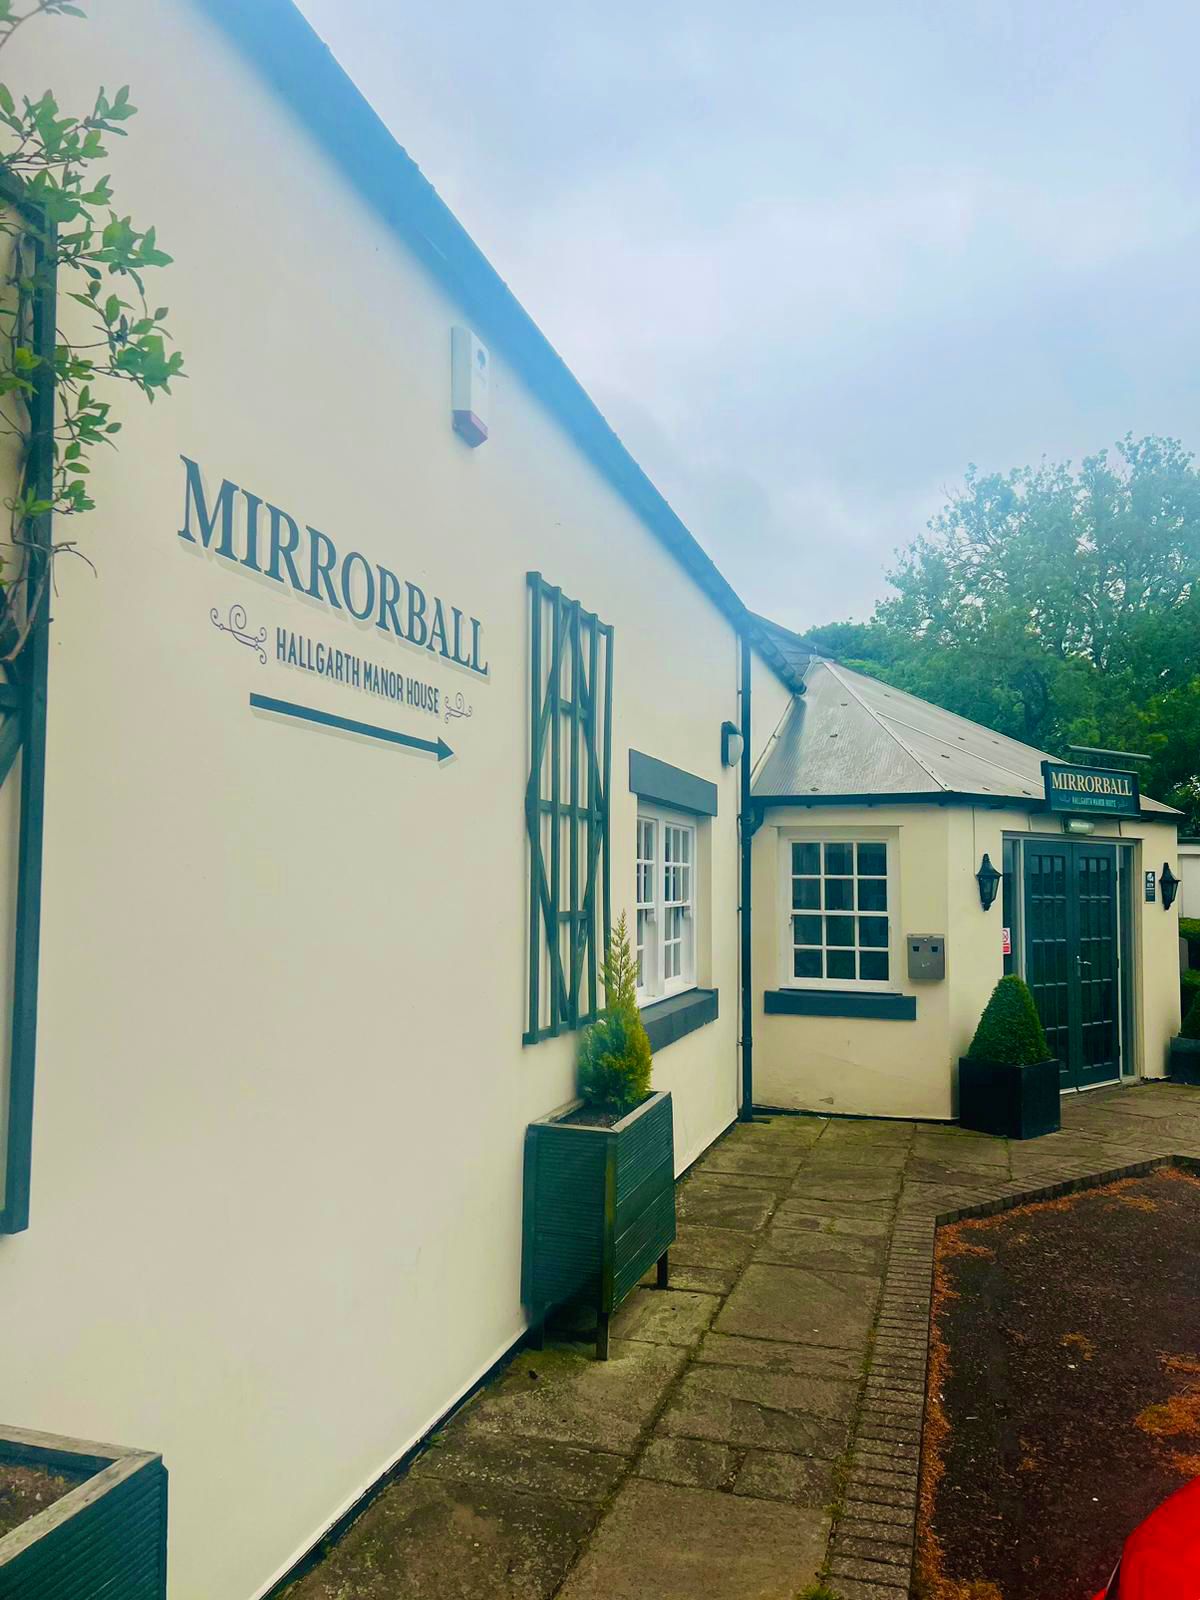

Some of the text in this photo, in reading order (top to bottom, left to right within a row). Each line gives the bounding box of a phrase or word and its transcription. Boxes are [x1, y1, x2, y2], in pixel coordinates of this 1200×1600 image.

[177, 454, 489, 676] MIRRORBALL
[276, 627, 439, 714] HALLGARTH MANOR HOUSE
[1051, 771, 1133, 796] MIRRORBALL
